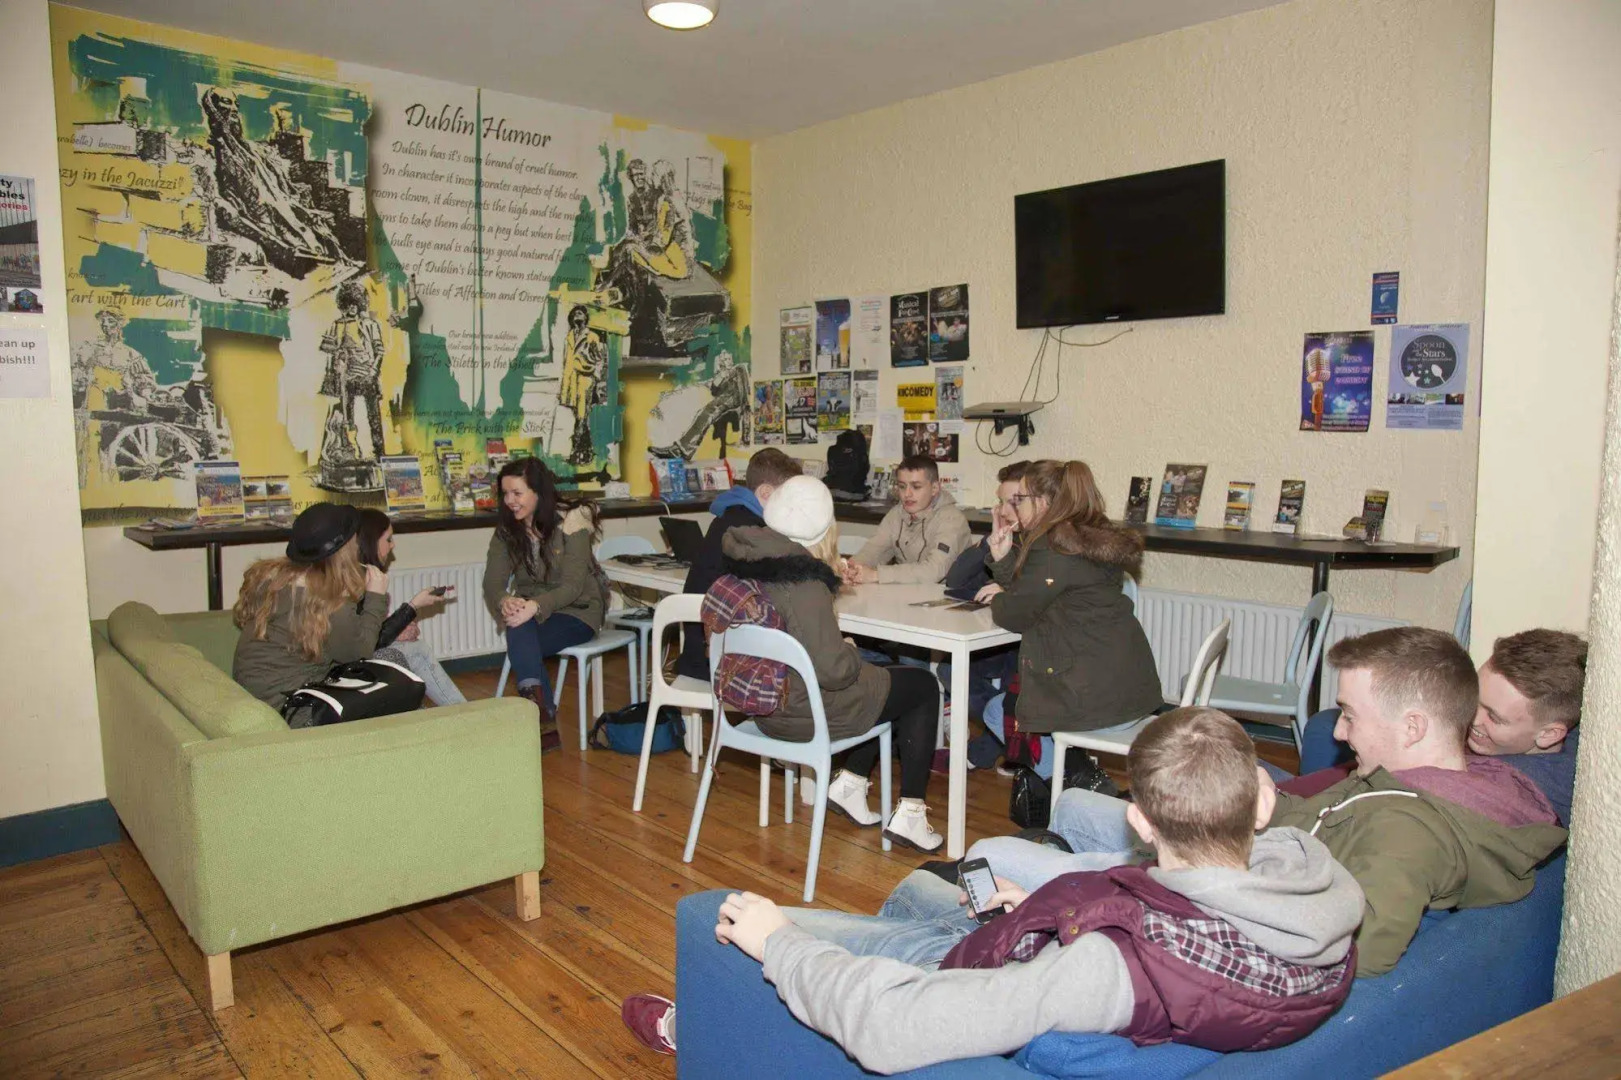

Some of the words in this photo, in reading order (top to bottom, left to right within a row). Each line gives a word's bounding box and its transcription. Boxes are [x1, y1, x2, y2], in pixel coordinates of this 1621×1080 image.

[405, 103, 475, 136] Dublin
[482, 117, 552, 148] Humor
[392, 140, 427, 157] Dublin
[429, 145, 446, 160] has
[448, 150, 461, 161] it's
[463, 157, 482, 166] own
[484, 153, 513, 170] brand
[515, 159, 526, 174] of
[525, 162, 549, 175] cruel
[548, 163, 579, 180] humor.
[82, 168, 96, 181] in
[101, 166, 123, 184] the
[382, 162, 396, 175] In
[397, 163, 445, 182] character
[446, 175, 454, 183] it
[455, 177, 512, 192] incoporates
[512, 184, 542, 199] aspects
[543, 190, 555, 202] of
[555, 186, 568, 200] the
[371, 187, 398, 198] room
[400, 186, 430, 205] clown,
[433, 193, 442, 205] it
[442, 192, 489, 214] disrespts
[491, 199, 507, 212] the
[508, 200, 528, 220] high
[529, 204, 547, 218] and
[548, 205, 562, 219] the
[374, 211, 397, 223] ims
[399, 213, 409, 225] to
[411, 212, 432, 231] take
[434, 214, 459, 229] them
[460, 217, 485, 233] down
[494, 224, 512, 242] peg
[513, 222, 530, 238] but
[530, 225, 553, 239] when
[390, 232, 413, 248] bulls
[415, 240, 430, 256] eye
[433, 239, 453, 252] and
[454, 244, 462, 254] is
[463, 241, 495, 261] always
[496, 244, 520, 263] good
[520, 249, 554, 262] natured
[412, 259, 424, 275] of
[425, 260, 465, 276] Dublin's
[467, 262, 494, 278] better
[495, 265, 525, 281] known
[97, 290, 127, 306] with
[131, 293, 154, 307] the
[413, 282, 440, 297] Titles
[442, 284, 453, 300] of
[453, 285, 496, 302] Affection
[499, 288, 518, 301] and
[21, 341, 36, 350] up
[1413, 339, 1445, 351] Spoon
[1422, 349, 1446, 358] Stars
[492, 355, 507, 370] the
[434, 420, 452, 434] The
[484, 421, 503, 433] with
[505, 419, 520, 433] the
